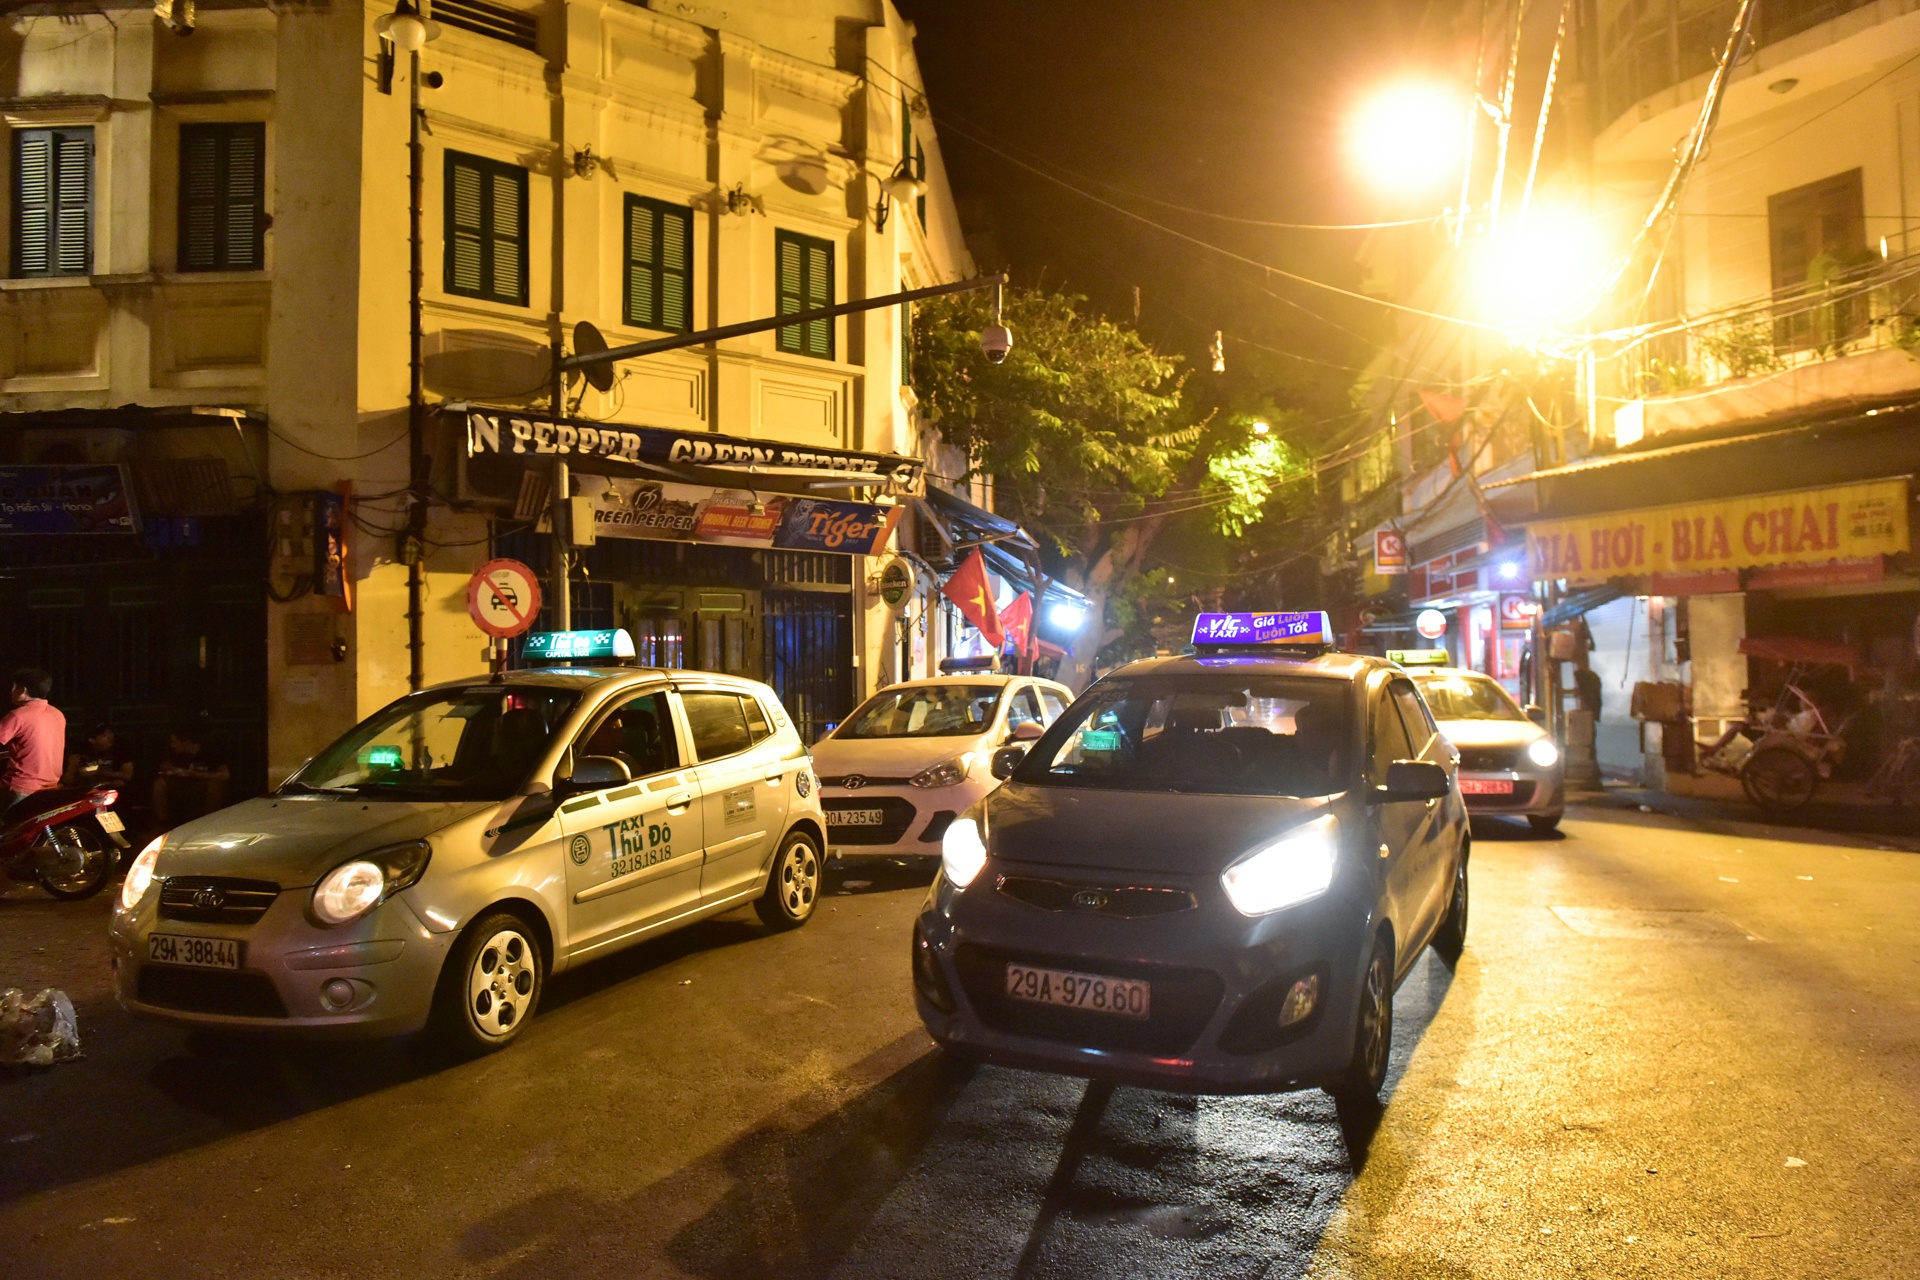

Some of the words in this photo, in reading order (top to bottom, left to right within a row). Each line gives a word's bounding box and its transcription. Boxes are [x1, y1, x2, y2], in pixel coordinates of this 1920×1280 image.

[510, 419, 642, 463] PEPPER
[594, 509, 636, 525] REEN
[636, 512, 693, 530] PEPPER
[808, 511, 876, 548] Tiger
[1534, 531, 1582, 574] BIA
[1671, 514, 1733, 563] BIA
[1742, 502, 1839, 557] CHAI
[1209, 629, 1239, 638] TAXI
[1253, 616, 1275, 628] Giá
[1255, 627, 1287, 641] Luôn
[1288, 621, 1309, 635] Tốt
[648, 822, 672, 848] Đô
[611, 845, 672, 878] 32.18.18.18
[1010, 968, 1144, 1014] 29A-978.60
